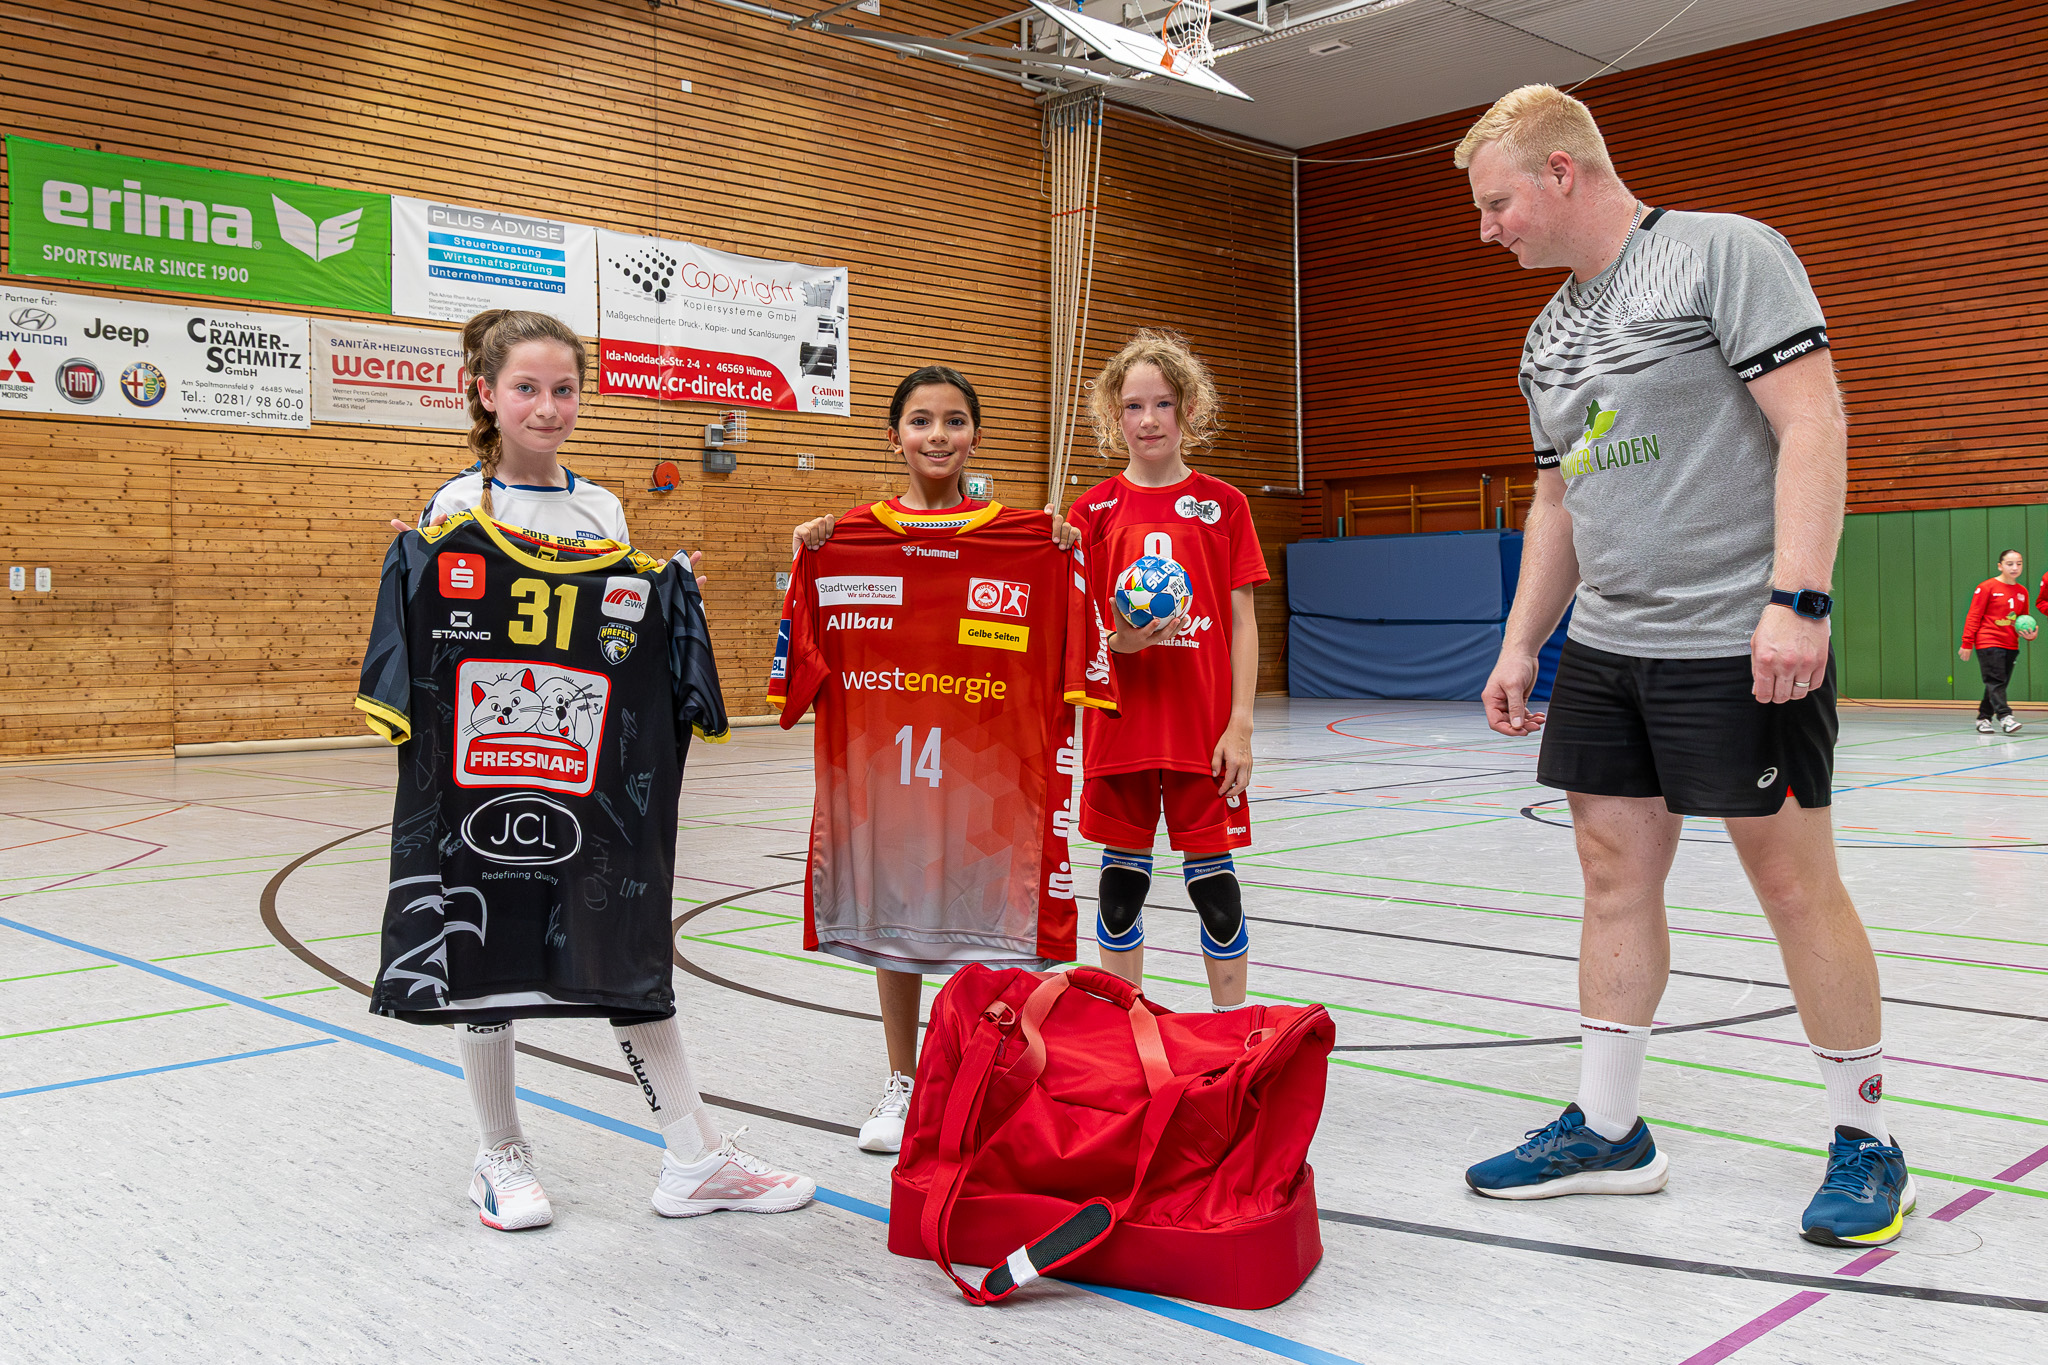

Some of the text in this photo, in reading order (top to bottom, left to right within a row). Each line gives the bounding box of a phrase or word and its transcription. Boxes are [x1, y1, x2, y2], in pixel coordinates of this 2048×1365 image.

[42, 179, 253, 249] erima
[432, 210, 560, 240] PLUS ADVISE
[454, 237, 541, 258] Steuerberatung
[43, 244, 249, 283] SPORTSWEAR SINCE 1900
[443, 252, 553, 275] Wirtschaftsprüfung
[431, 267, 563, 292] Unternehmensberatung
[682, 262, 793, 304] Copyright
[5, 293, 57, 306] Partner für:
[684, 299, 797, 322] Kopiersysteme GmbH
[83, 318, 149, 347] Jeep
[187, 317, 290, 350] CRAMER-
[210, 320, 262, 331] Autohaus
[606, 309, 676, 326] Maßgeschneiderte
[705, 322, 730, 335] Kopier-
[732, 326, 746, 336] und
[749, 328, 796, 342] Scanlösungen
[0, 331, 68, 346] HYUNDAI
[206, 346, 301, 373] SCHMITZ
[1773, 339, 1814, 363] Kempa
[225, 366, 258, 377] GmbH
[332, 355, 445, 383] werner
[606, 350, 772, 378] Ida-Noddack-Str. 2-4 46569 Hünxe
[67, 371, 95, 393] FIAT
[285, 387, 303, 395] Wesel
[606, 371, 773, 402] www.cr-direkt.de
[812, 385, 844, 397] Canon
[181, 391, 303, 409] Tel.: 0281/ 98 60-0
[420, 395, 464, 410] GmbH
[821, 398, 844, 408] Colortrac
[182, 406, 304, 421] www.cramer-schmitz.de
[1595, 434, 1661, 471] LADEN
[1089, 497, 1118, 513] Kempa
[522, 528, 550, 542] 2013
[556, 536, 586, 548] 2023
[916, 546, 959, 560] hummel
[1146, 561, 1180, 590] SELECT
[819, 581, 897, 594] Stadtwerkessen
[871, 592, 897, 600] Zuhause.
[1173, 583, 1186, 597] PLAY
[508, 577, 579, 651] 31
[624, 599, 645, 609] SWK
[2007, 597, 2015, 609] 1
[826, 612, 894, 631] Allbau
[432, 629, 491, 641] STANNO
[967, 627, 1020, 643] Gelbe Seiten
[842, 667, 1007, 704] westenergie
[470, 750, 585, 775] FRESSNAPF
[895, 724, 943, 788] 14
[490, 812, 555, 849] JCL
[481, 871, 531, 881] Redefining
[620, 1040, 662, 1113] Kempa
